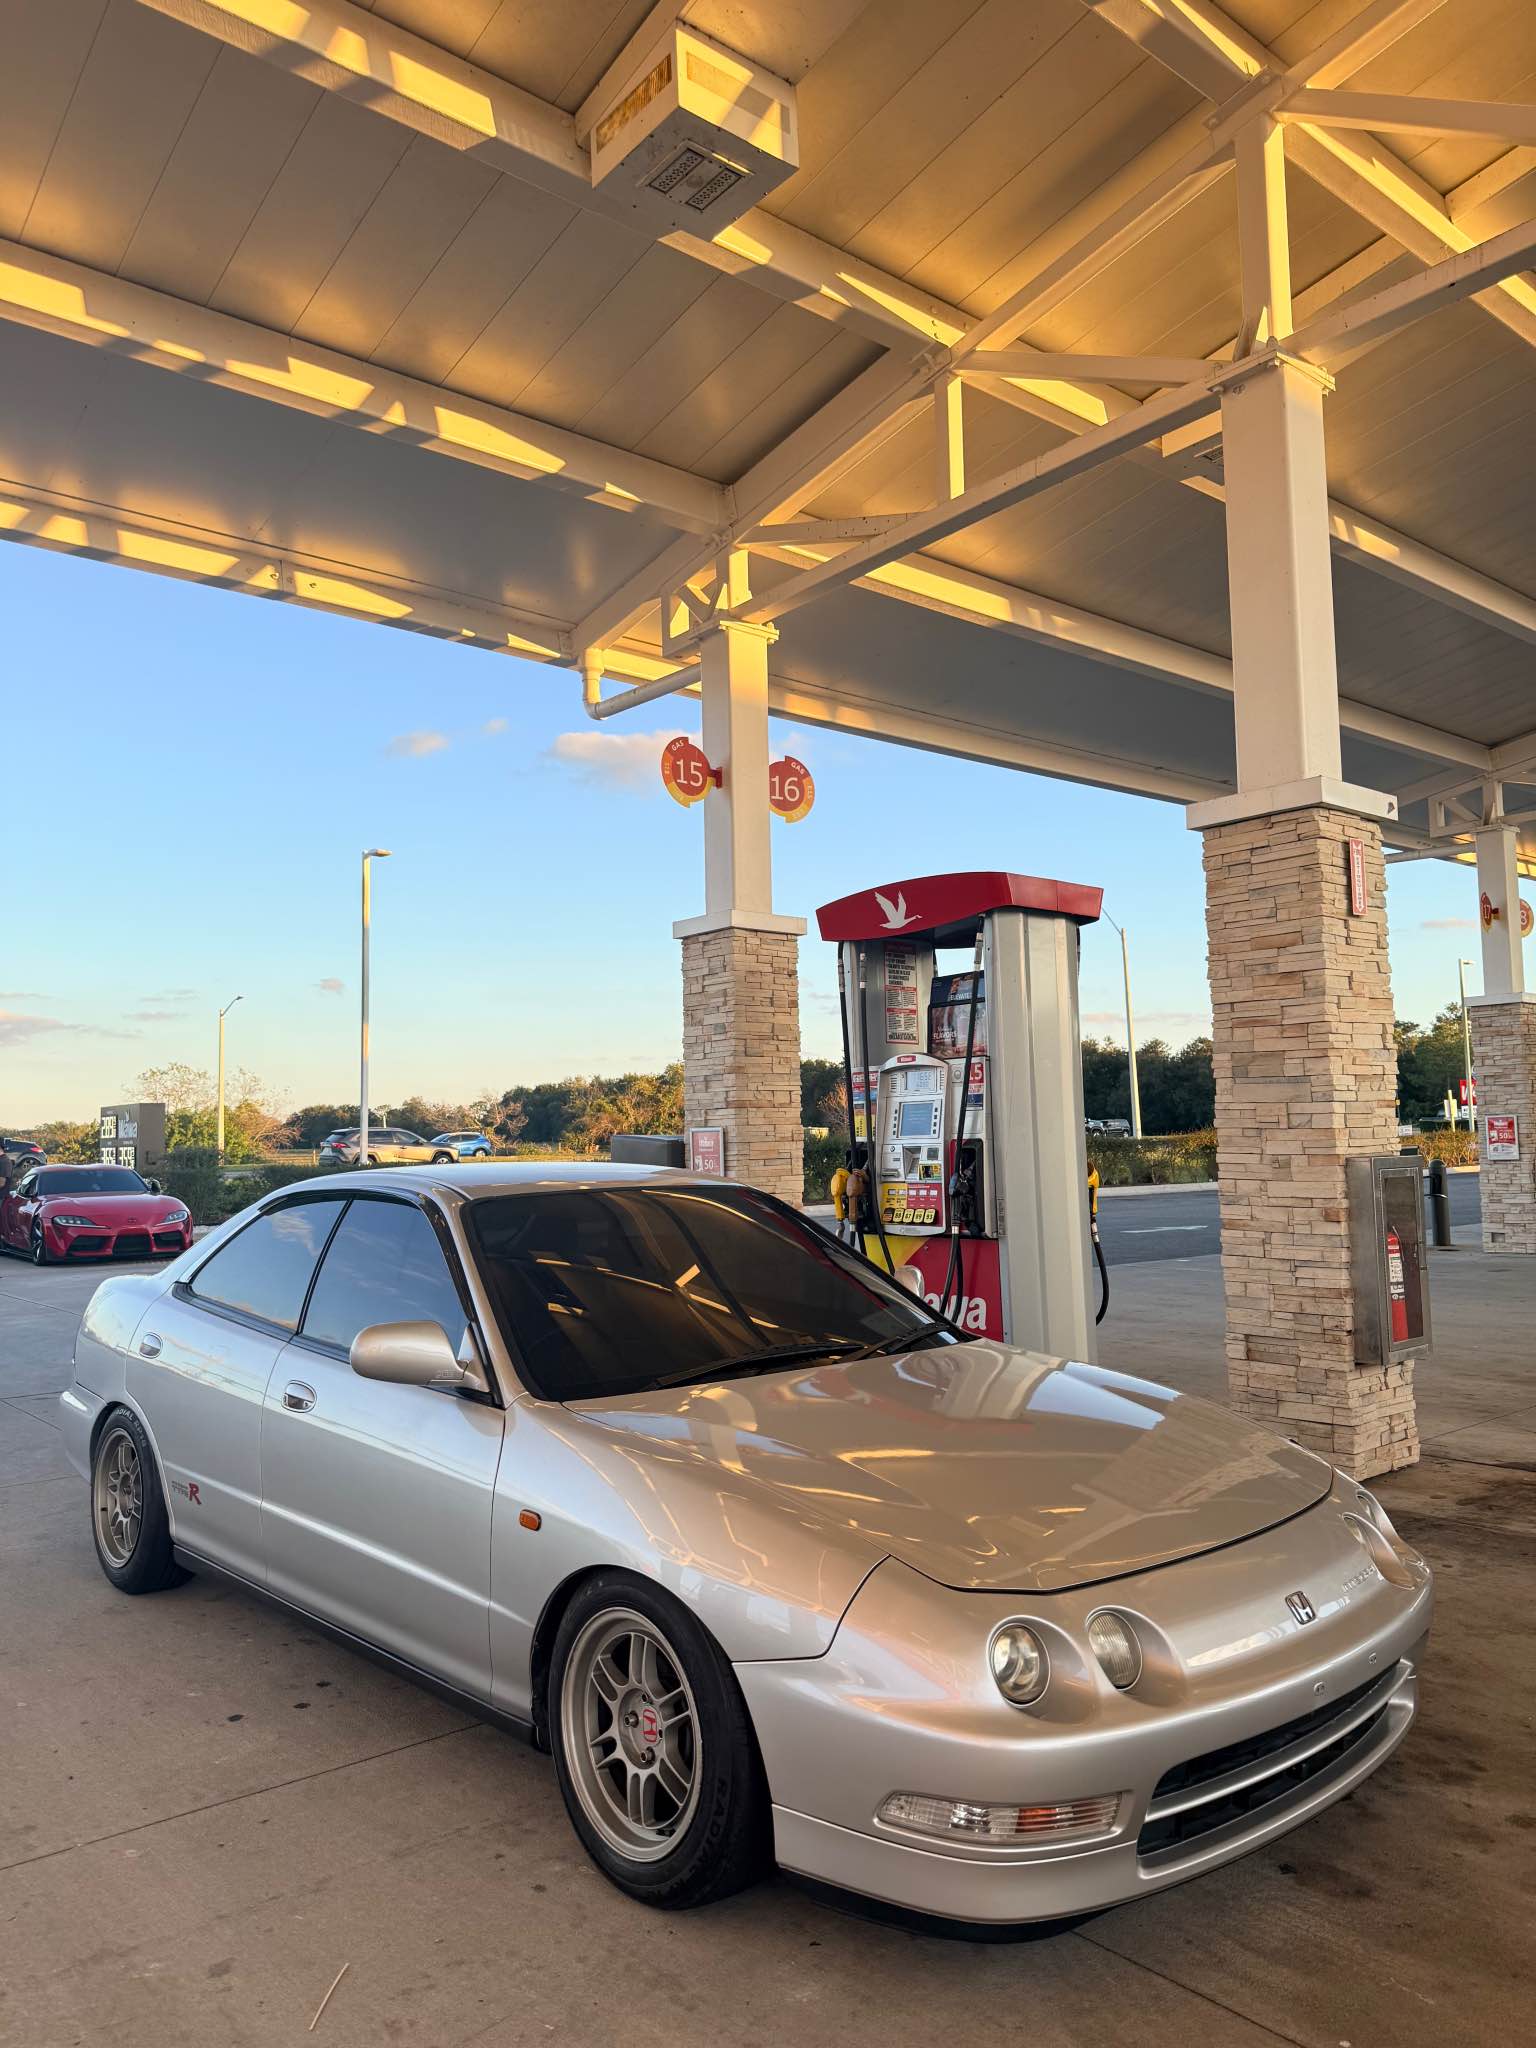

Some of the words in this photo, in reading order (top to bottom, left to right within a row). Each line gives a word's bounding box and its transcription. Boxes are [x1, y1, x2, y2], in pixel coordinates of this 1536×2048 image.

[671, 740, 685, 751] GAS
[676, 758, 703, 787] 15
[790, 761, 806, 775] GAS
[771, 775, 800, 802] 16
[1484, 904, 1491, 919] 17
[188, 1482, 202, 1505] R
